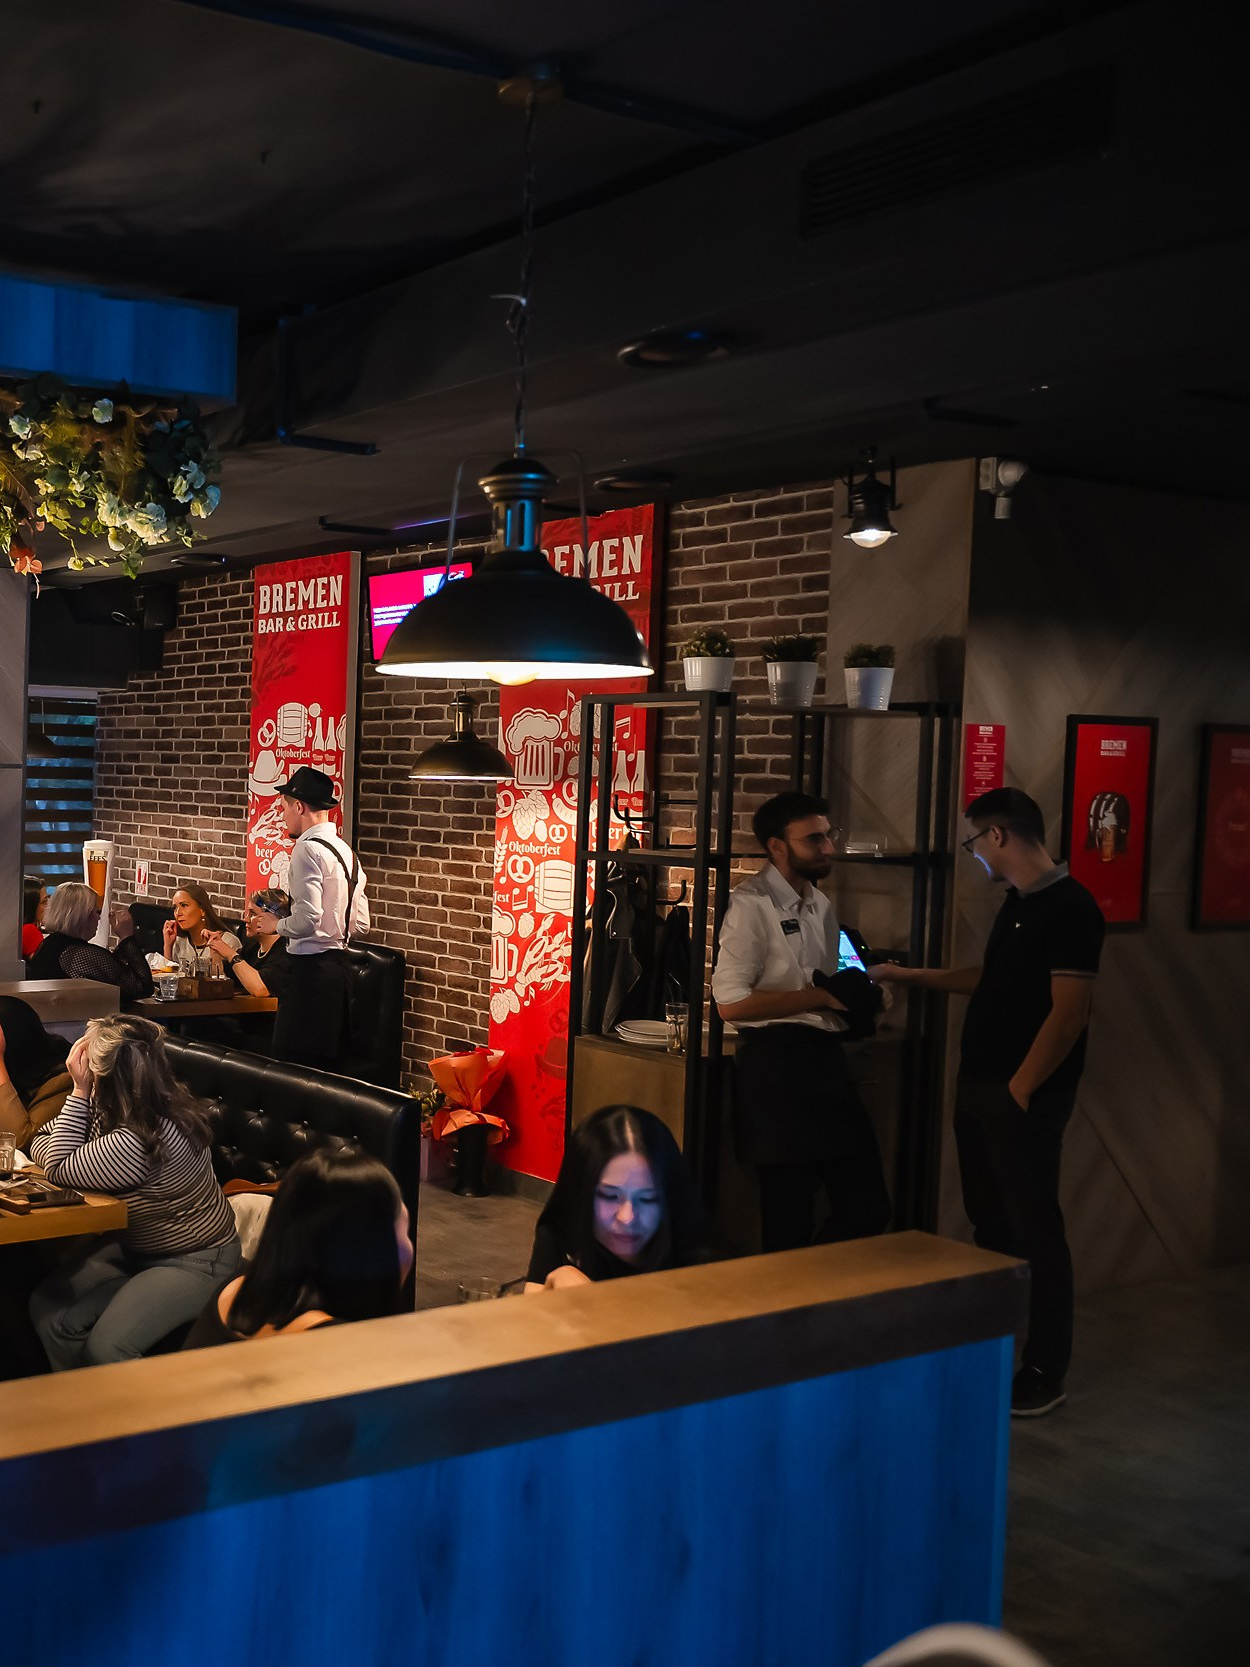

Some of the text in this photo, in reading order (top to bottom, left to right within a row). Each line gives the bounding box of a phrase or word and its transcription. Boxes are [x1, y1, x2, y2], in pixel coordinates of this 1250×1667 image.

[541, 535, 644, 579] EMEN
[258, 574, 344, 615] BREMEN
[258, 611, 341, 634] BAR & GRILL
[275, 748, 311, 760] Oktoberfest
[255, 843, 275, 858] beer
[509, 841, 562, 857] Oktoberfest
